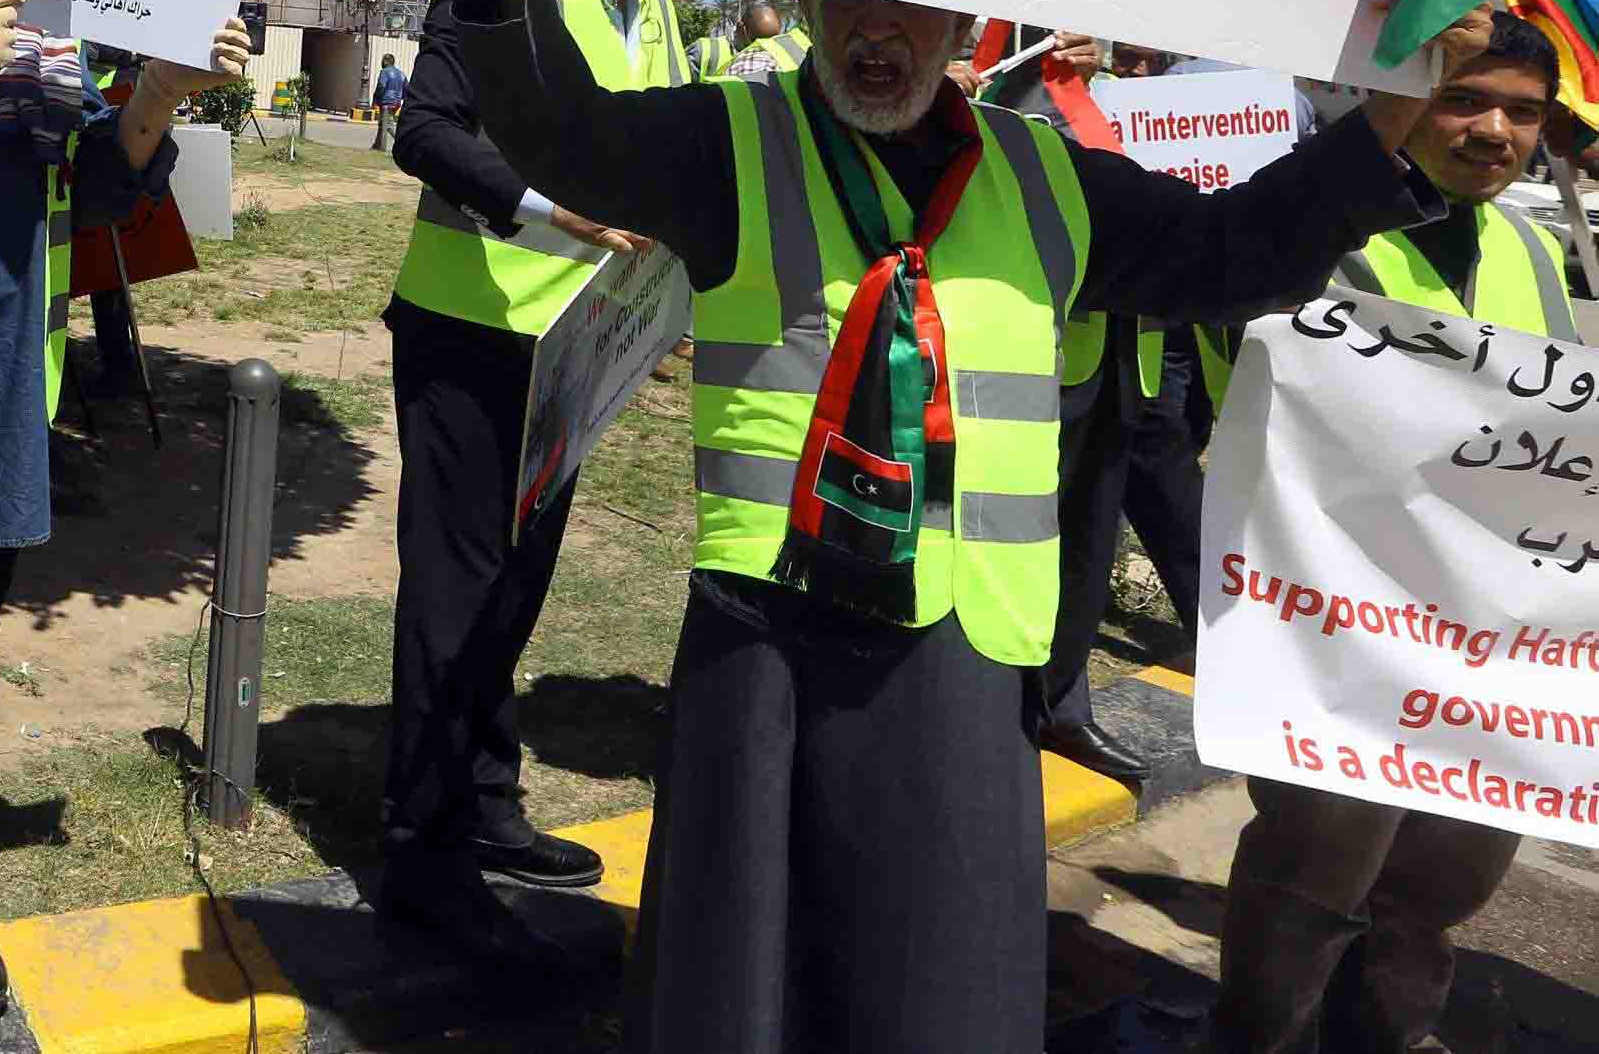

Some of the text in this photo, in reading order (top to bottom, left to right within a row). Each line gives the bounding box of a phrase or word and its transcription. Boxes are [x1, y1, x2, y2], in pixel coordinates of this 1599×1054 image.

[1130, 102, 1291, 143] l'intervention
[1290, 295, 1599, 413] ول أخرى
[1451, 424, 1599, 496] علان
[1220, 551, 1502, 669] Supporting
[1281, 720, 1324, 771] is
[1336, 745, 1369, 781] a
